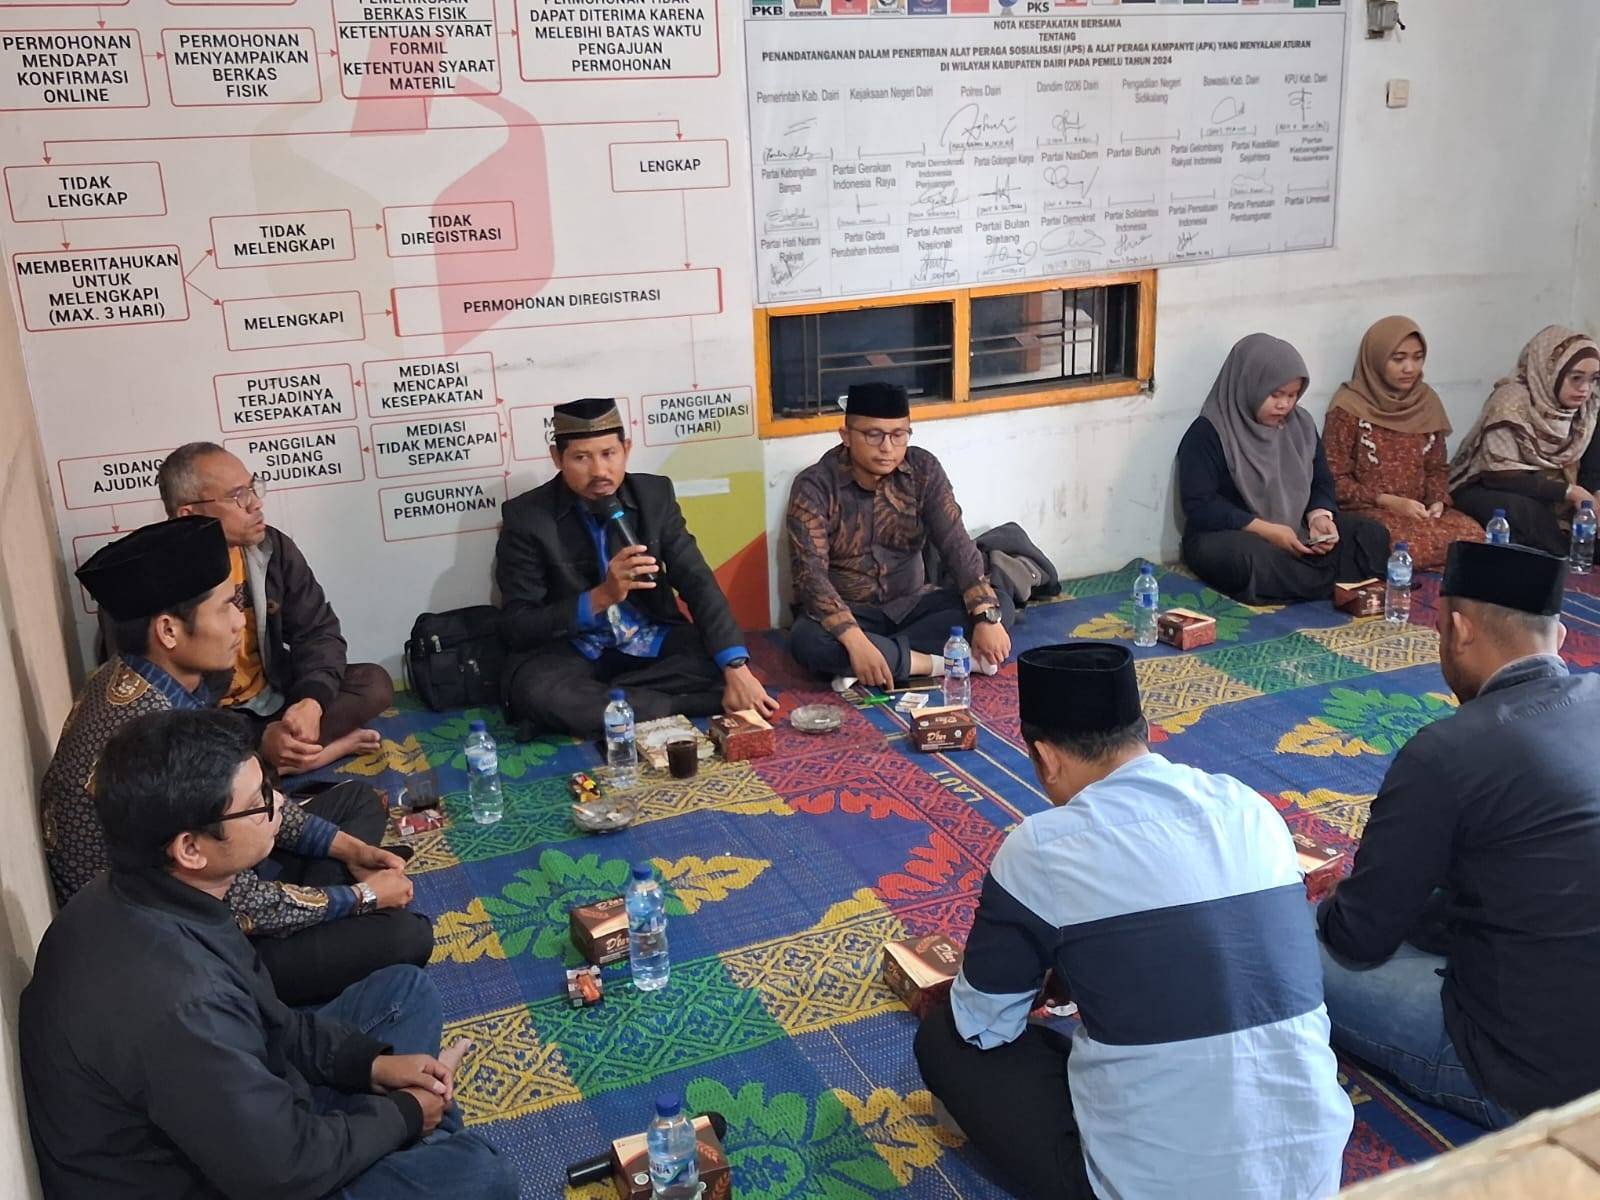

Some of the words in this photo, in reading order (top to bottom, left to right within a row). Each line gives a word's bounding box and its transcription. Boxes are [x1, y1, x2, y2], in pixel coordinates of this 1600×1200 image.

[364, 7, 424, 20] BERKAS
[429, 7, 467, 20] FISIK
[530, 9, 576, 22] DAPAT
[579, 8, 646, 22] DITERIMA
[649, 8, 705, 21] KARENA
[752, 6, 783, 16] PKB
[1027, 2, 1050, 13] PKS
[340, 25, 431, 39] KETENTUAN
[435, 24, 492, 37] SYARAT
[535, 26, 602, 39] MELEBIHI
[606, 25, 651, 38] BATAS
[653, 24, 702, 37] WAKTU
[994, 21, 1016, 29] NOTA
[1019, 19, 1079, 29] KESEPAKATAN
[1081, 19, 1122, 28] BERSAMA
[3, 35, 131, 50] PERMOHONAN
[179, 34, 300, 48] PERMOHONAN
[1039, 32, 1076, 41] TENTANG
[390, 42, 448, 55] FORMIL
[578, 42, 663, 56] PENGAJUAN
[762, 51, 856, 61] PENANDATANGANAN
[858, 50, 890, 59] DALAM
[892, 49, 947, 59] PENERTIBAN
[950, 48, 970, 56] ALAT
[972, 47, 1007, 56] PERAGA
[1009, 45, 1061, 55] SOSIALISASI
[1095, 44, 1115, 53] ALAT
[1117, 43, 1149, 53] PERAGA
[1151, 43, 1194, 52] KAMPANYE
[1218, 42, 1238, 51] YANG
[1283, 40, 1311, 49] ATURAN
[22, 53, 118, 68] MENDAPAT
[174, 51, 309, 65] MENYAMPAIKAN
[571, 58, 672, 73] PERMOHONAN
[941, 62, 949, 71] DI
[951, 62, 990, 71] WILAYAH
[992, 61, 1041, 70] KABUPATEN
[1043, 59, 1066, 68] DAIRI
[1068, 59, 1090, 68] PADA
[1092, 58, 1122, 67] PEMILU
[1125, 57, 1150, 66] TAHUN
[1152, 56, 1172, 65] 2024
[212, 68, 278, 82] BERKAS
[344, 62, 435, 76] KETENTUAN
[438, 59, 496, 73] SYARAT
[17, 71, 129, 86] KONFIRMASI
[390, 76, 456, 90] MATERIL
[44, 89, 109, 103] ONLINE
[226, 84, 269, 98] FISIK
[640, 159, 701, 174] LENGKAP
[59, 176, 112, 190] TIDAK
[47, 192, 129, 208] LENGKAP
[428, 214, 472, 229] TIDAK
[259, 223, 307, 237] TIDAK
[401, 228, 502, 246] DIREGISTRASI
[234, 238, 335, 257] MELENGKAPI
[17, 253, 179, 276] MEMBERITAHUKAN
[72, 273, 131, 289] UNTUK
[49, 288, 159, 307] MELENGKAPI
[463, 295, 565, 314] PERMOHONAN
[569, 289, 661, 307] DIREGISTRASI
[49, 308, 99, 326] (MAX.
[104, 306, 115, 320] 3
[118, 303, 165, 319] HARI)
[244, 311, 345, 331] MELENGKAPI
[399, 361, 460, 378] MEDIASI
[247, 374, 321, 392] PUTUSAN
[393, 376, 468, 393] MENCAPAI
[238, 389, 334, 408] TERJADINYA
[381, 389, 484, 410] KESEPAKATAN
[660, 394, 732, 411] PANGGILAN
[234, 403, 342, 424] KESEPAKATAN
[647, 410, 695, 425] SIDANG
[698, 405, 749, 421] MEDIASI
[406, 421, 466, 437] MEDIASI
[675, 420, 722, 438] (1HARI)
[248, 434, 336, 454] PANGGILAN
[377, 439, 421, 455] TIDAK
[424, 432, 497, 450] MENCAPAI
[265, 450, 324, 467] SIDANG
[408, 449, 471, 466] SEPAKAT
[252, 464, 342, 481] ADJUDIKASI
[93, 475, 159, 493] AJUDIK
[404, 485, 484, 505] GUGURNYA
[393, 497, 496, 520] PERMOHONAN
